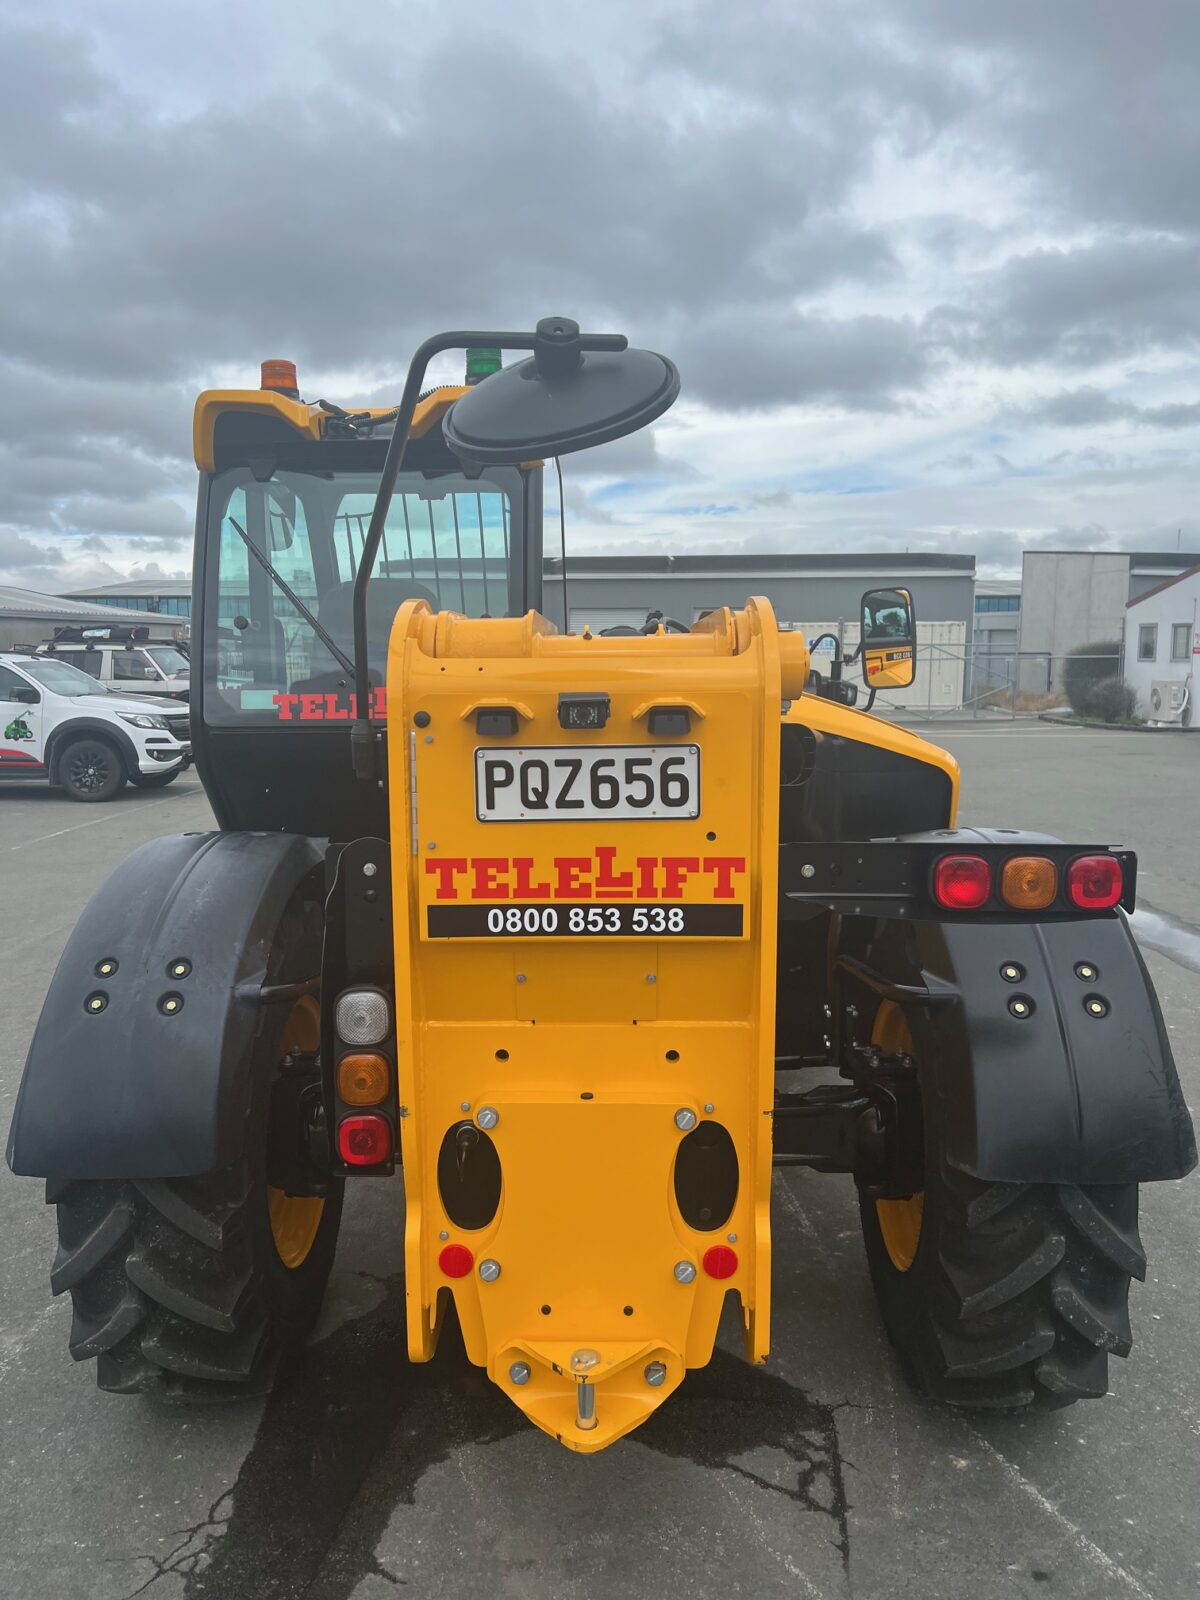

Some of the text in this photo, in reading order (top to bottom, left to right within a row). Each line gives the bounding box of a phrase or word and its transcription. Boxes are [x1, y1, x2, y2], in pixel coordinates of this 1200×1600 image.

[485, 757, 690, 811] PQZ656
[426, 847, 746, 900] TELELIFT
[488, 908, 685, 933] 0800 853 538
